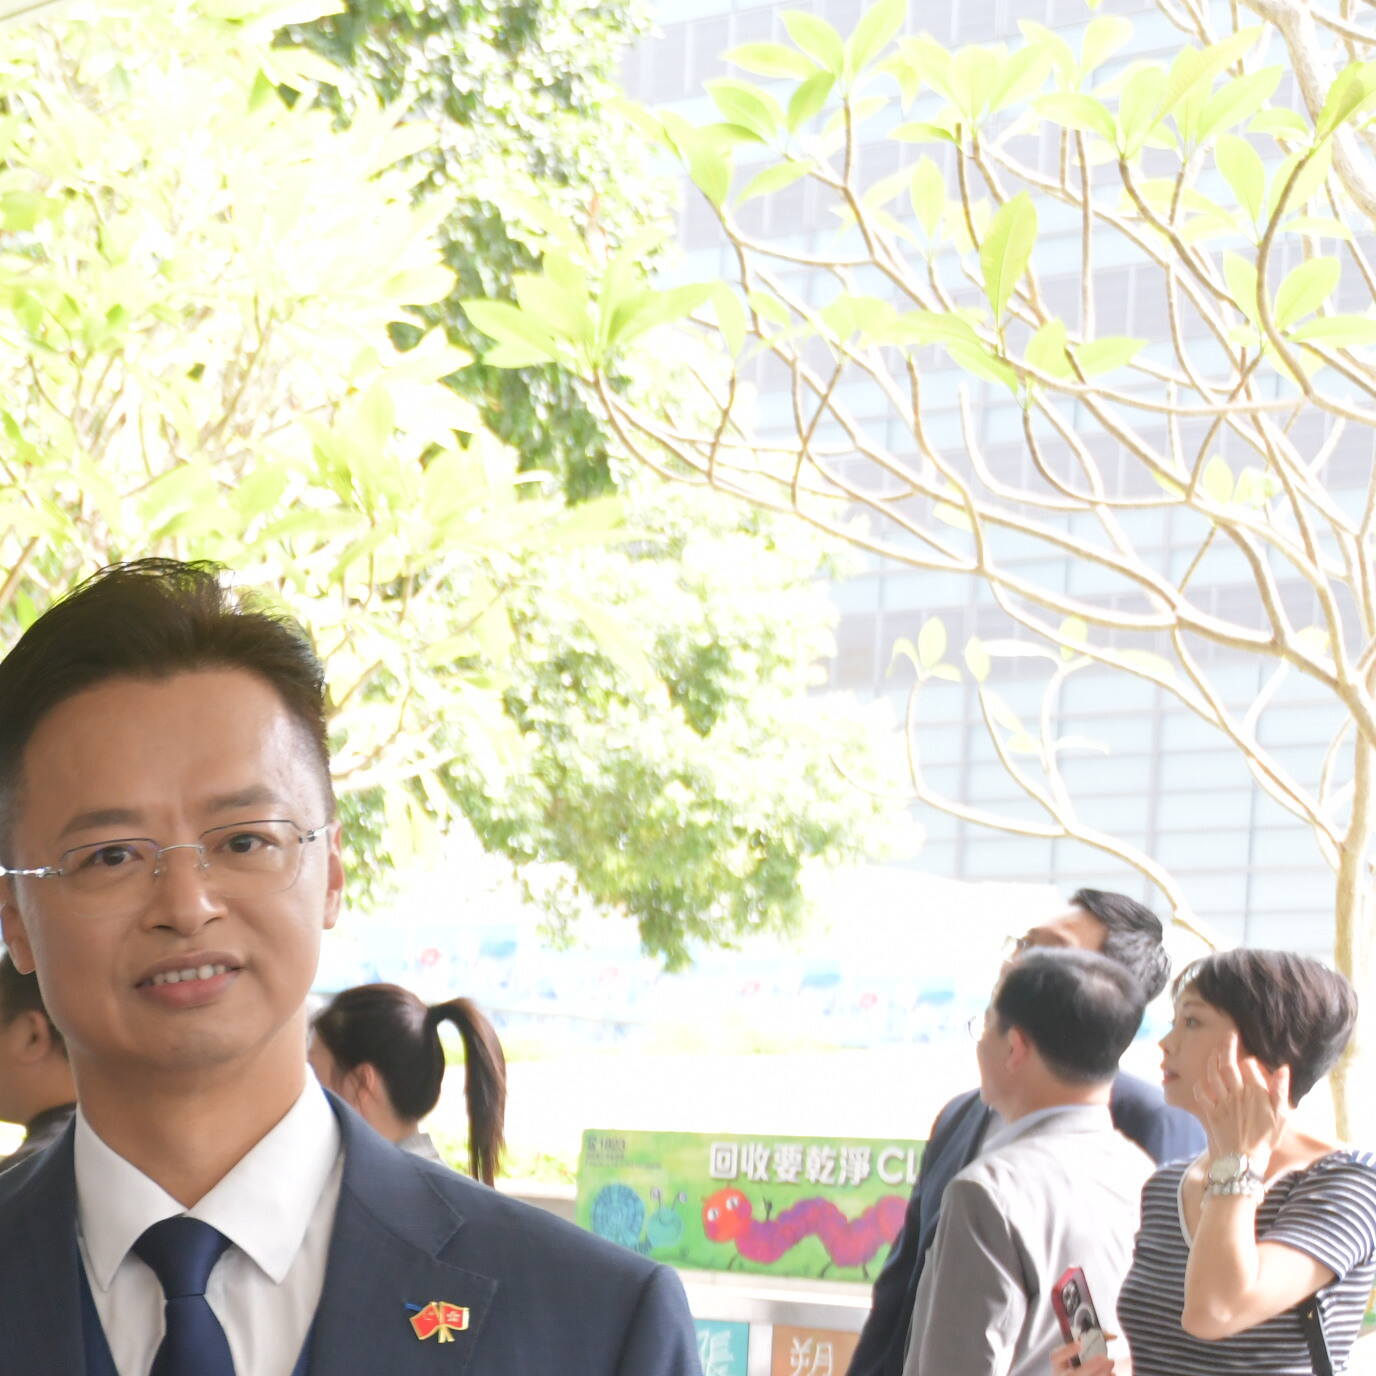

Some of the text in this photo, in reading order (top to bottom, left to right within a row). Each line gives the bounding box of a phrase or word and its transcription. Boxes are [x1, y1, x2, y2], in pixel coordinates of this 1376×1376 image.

[709, 1141, 871, 1187] 回收要乾淨
